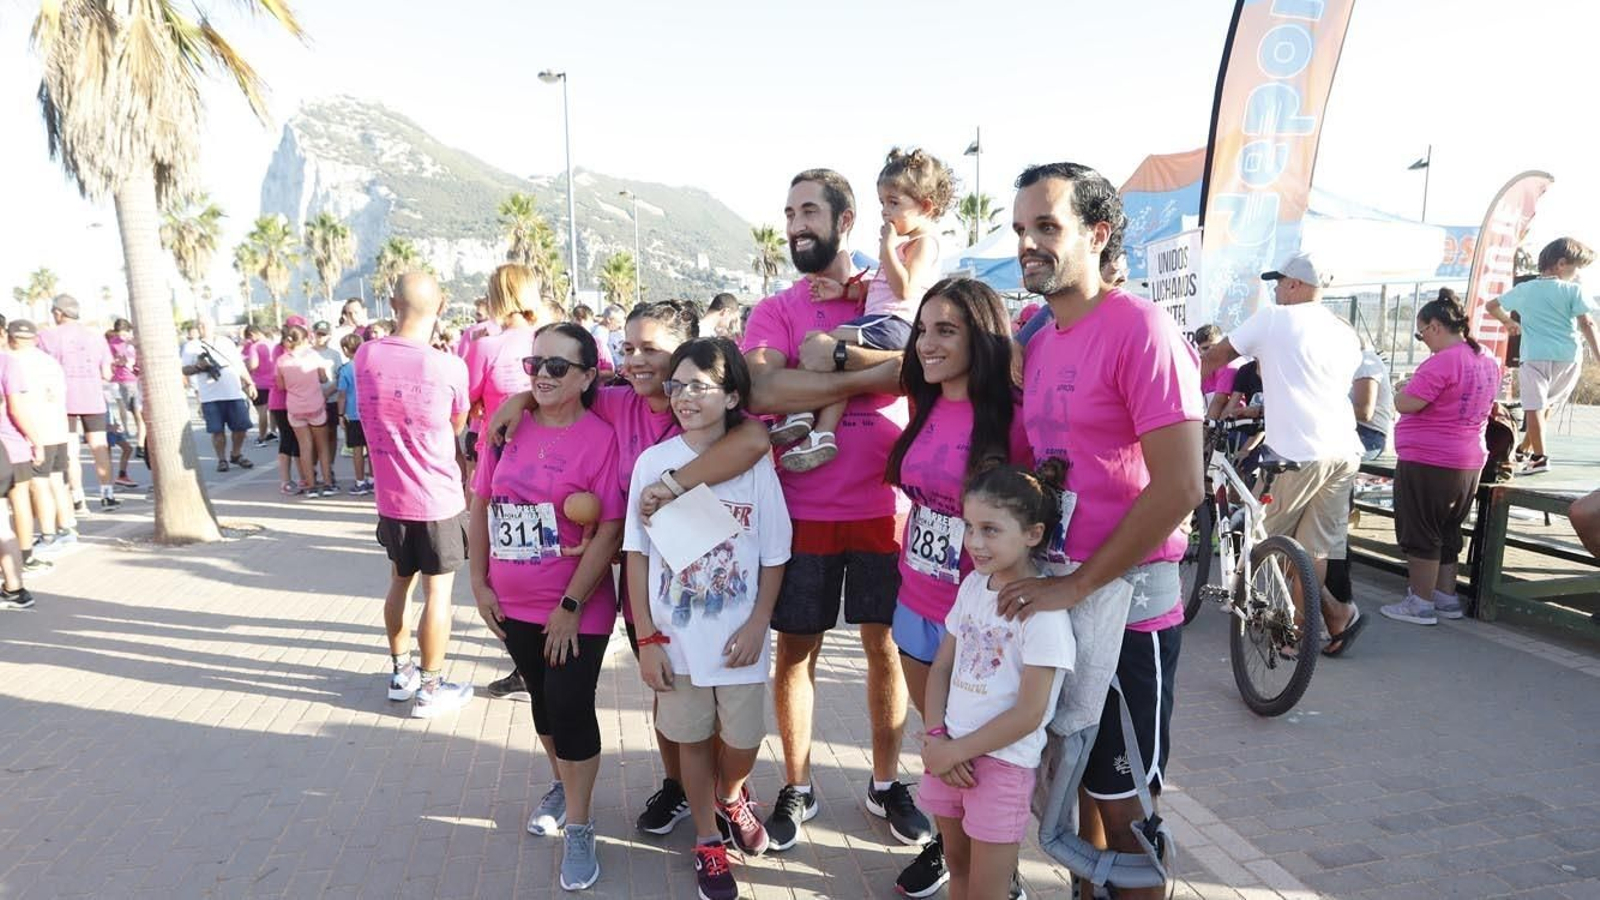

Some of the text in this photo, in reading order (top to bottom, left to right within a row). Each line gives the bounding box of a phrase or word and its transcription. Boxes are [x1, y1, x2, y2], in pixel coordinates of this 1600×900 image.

[1157, 245, 1189, 275] UNIDOS
[499, 517, 544, 547] 311
[911, 525, 950, 565] 283
